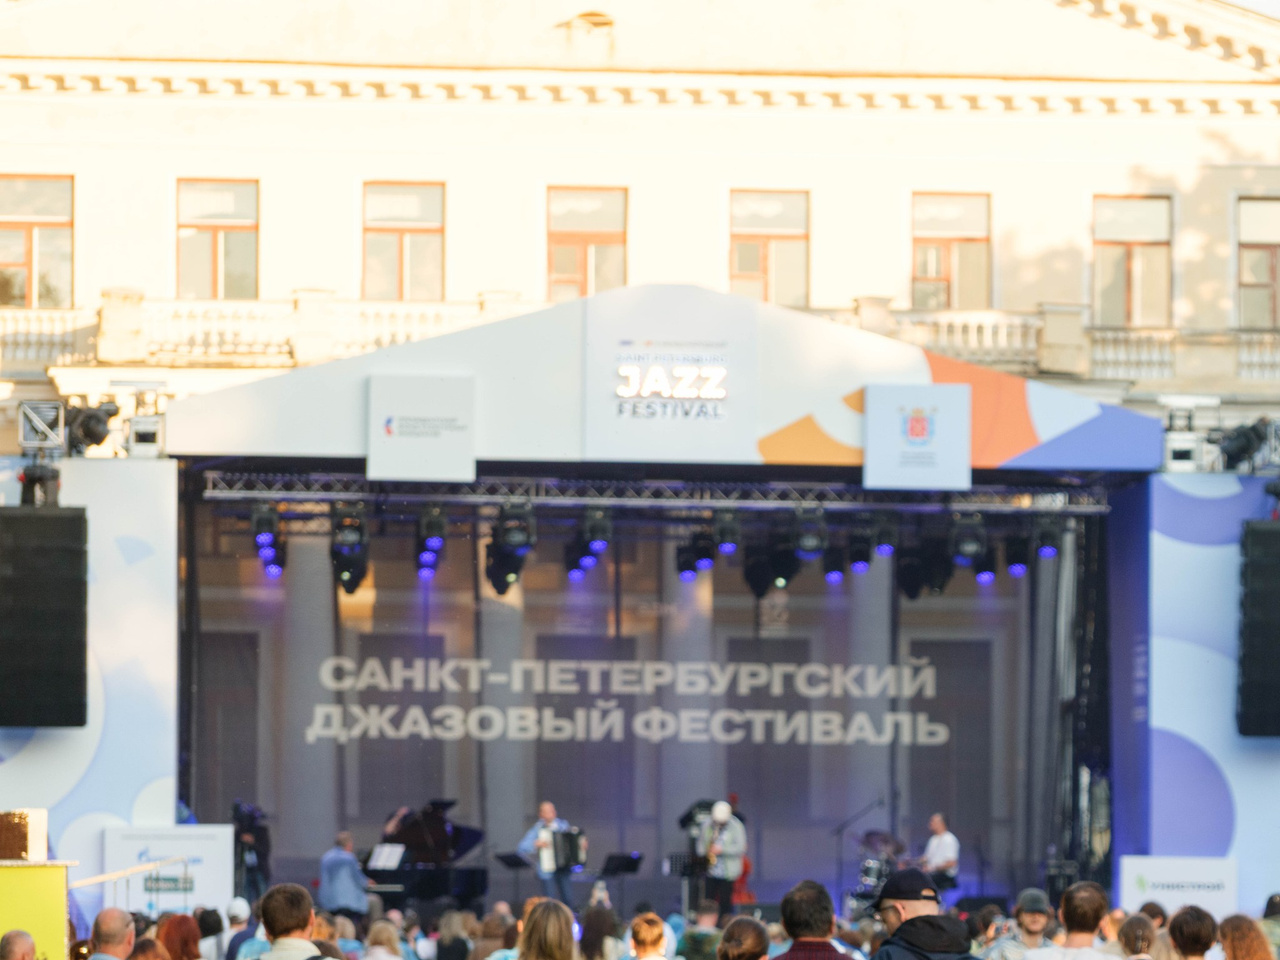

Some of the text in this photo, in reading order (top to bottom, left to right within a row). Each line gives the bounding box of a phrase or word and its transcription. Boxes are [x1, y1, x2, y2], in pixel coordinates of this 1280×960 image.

[616, 364, 728, 399] JAZZ
[617, 401, 726, 419] FESTIVAL
[319, 656, 937, 697] САНКТ-ПЕТЕРБУРГСКИЙ
[306, 699, 950, 746] ДЖАЗОВЫЙ ФЕСТИВАЛЬ
